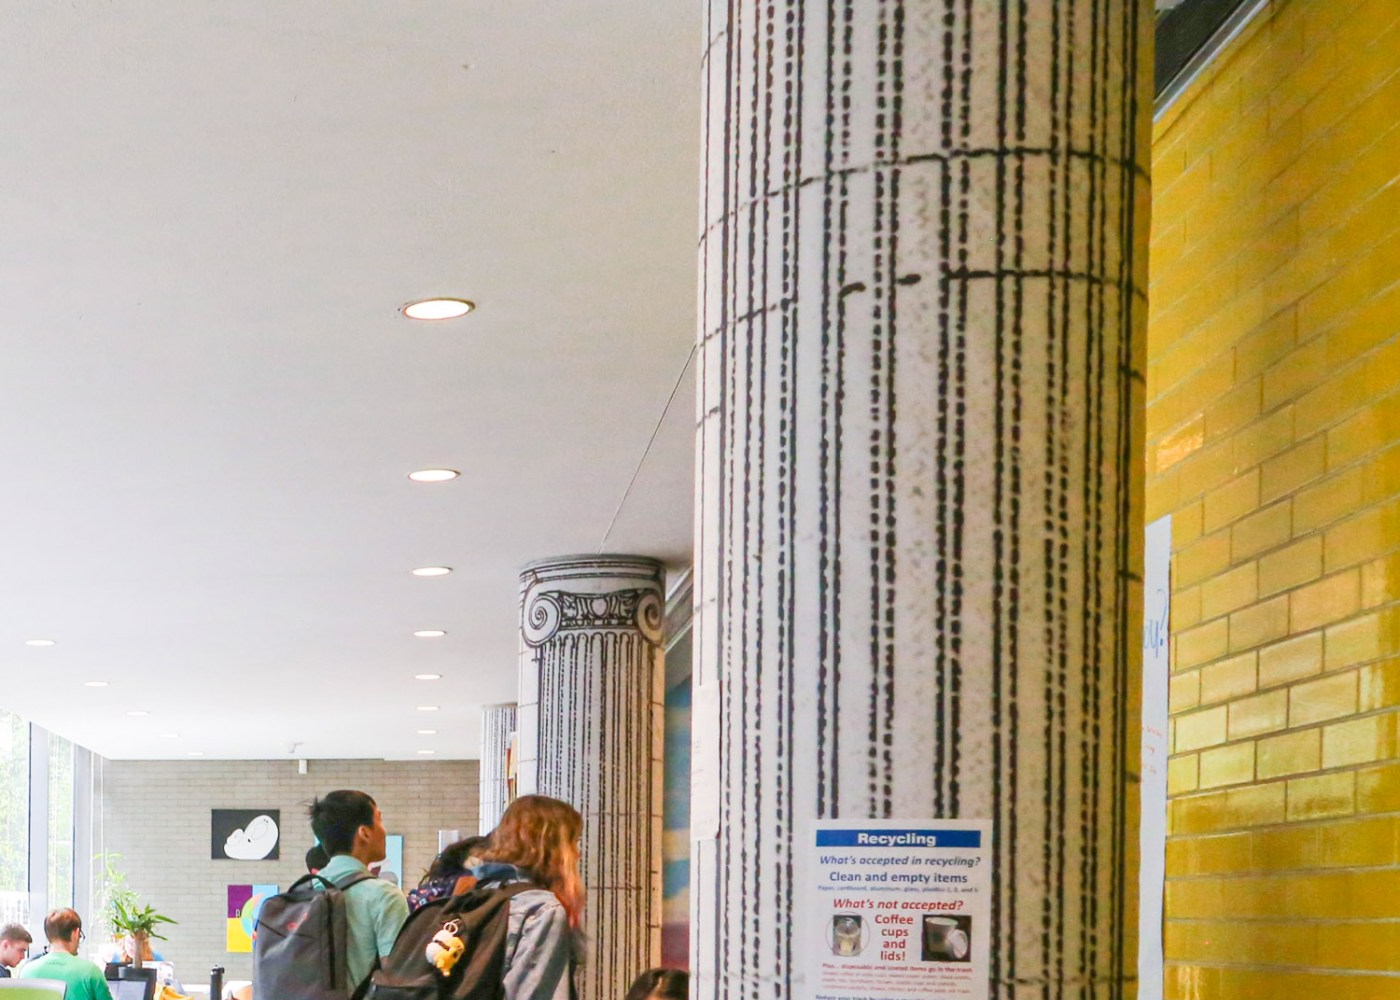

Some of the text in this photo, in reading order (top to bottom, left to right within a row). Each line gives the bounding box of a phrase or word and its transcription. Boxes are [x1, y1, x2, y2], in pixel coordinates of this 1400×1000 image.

[858, 833, 936, 847] Recycling
[820, 856, 981, 868] What's accepted in recycling?
[830, 872, 968, 885] Clean and empty items
[833, 899, 964, 911] What's not accepted?
[875, 914, 914, 925] Coffee
[881, 927, 909, 938] cups
[883, 939, 906, 949] and
[881, 951, 906, 961] lids!
